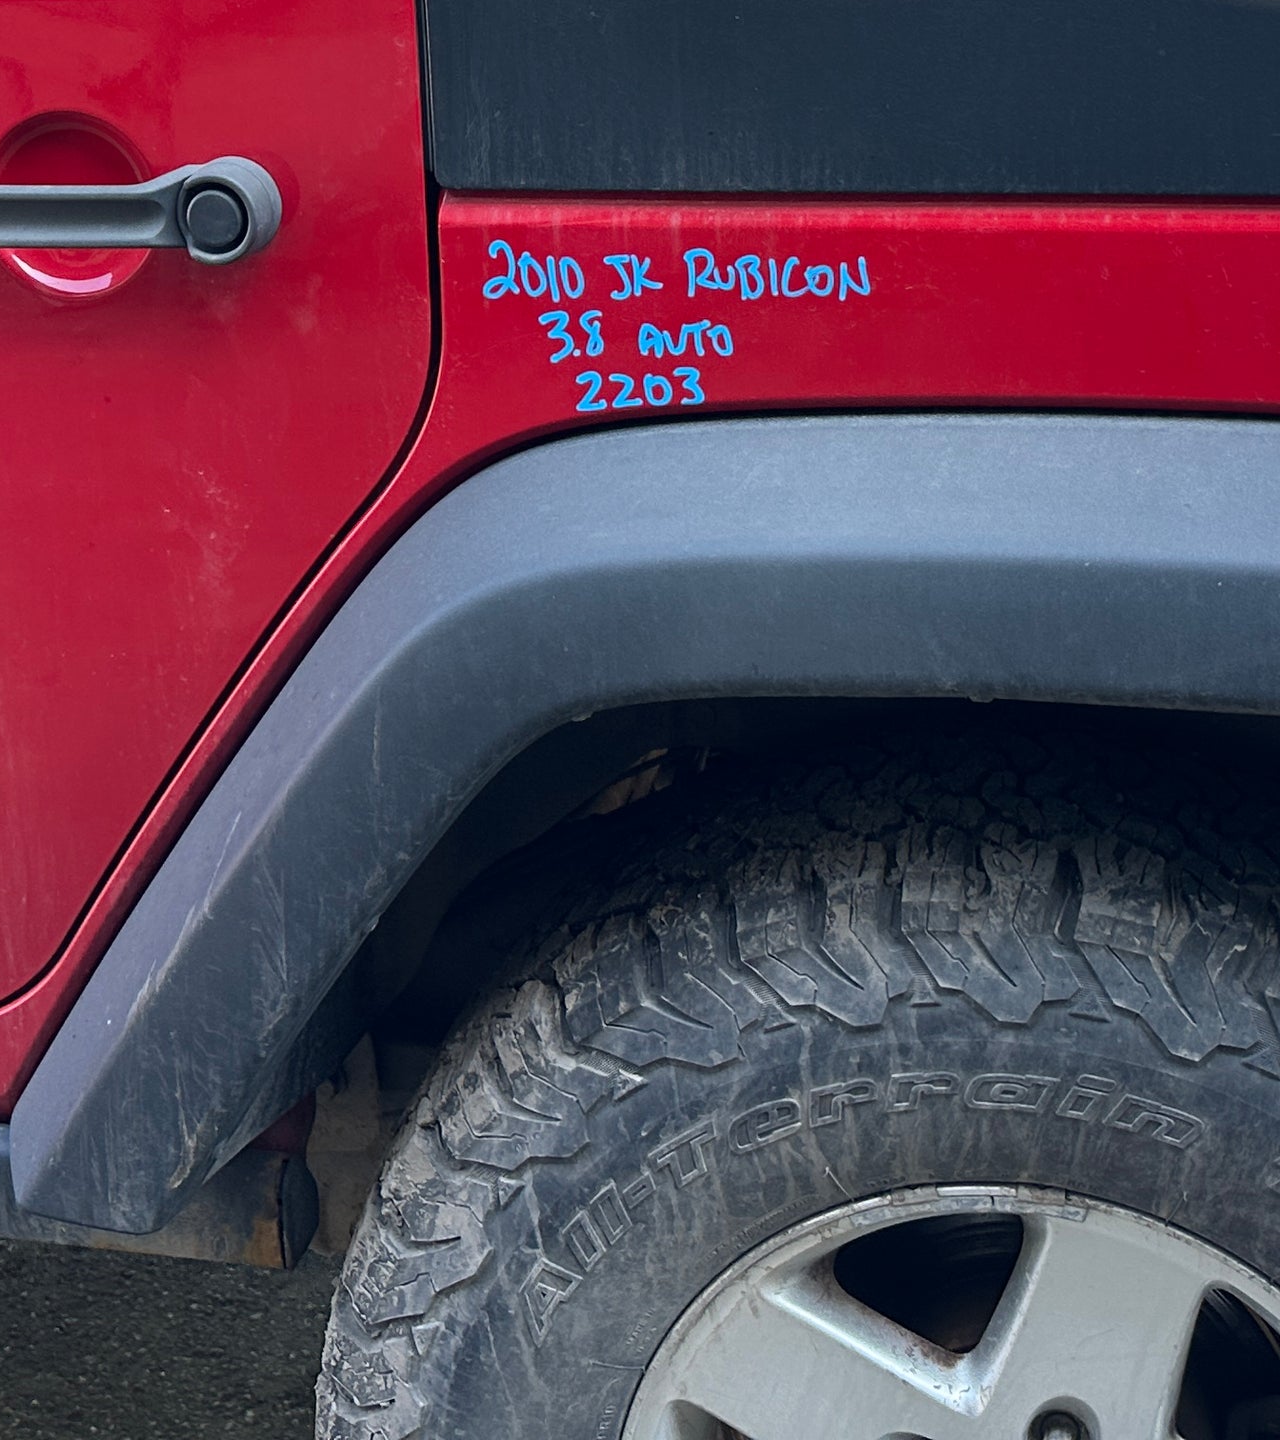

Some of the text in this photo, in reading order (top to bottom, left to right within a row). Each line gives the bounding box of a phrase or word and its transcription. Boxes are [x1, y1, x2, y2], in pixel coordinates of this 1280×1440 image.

[482, 239, 872, 302] 2010 JK RUBICON
[538, 309, 734, 363] 3.8 AUTO
[575, 366, 706, 411] 2203
